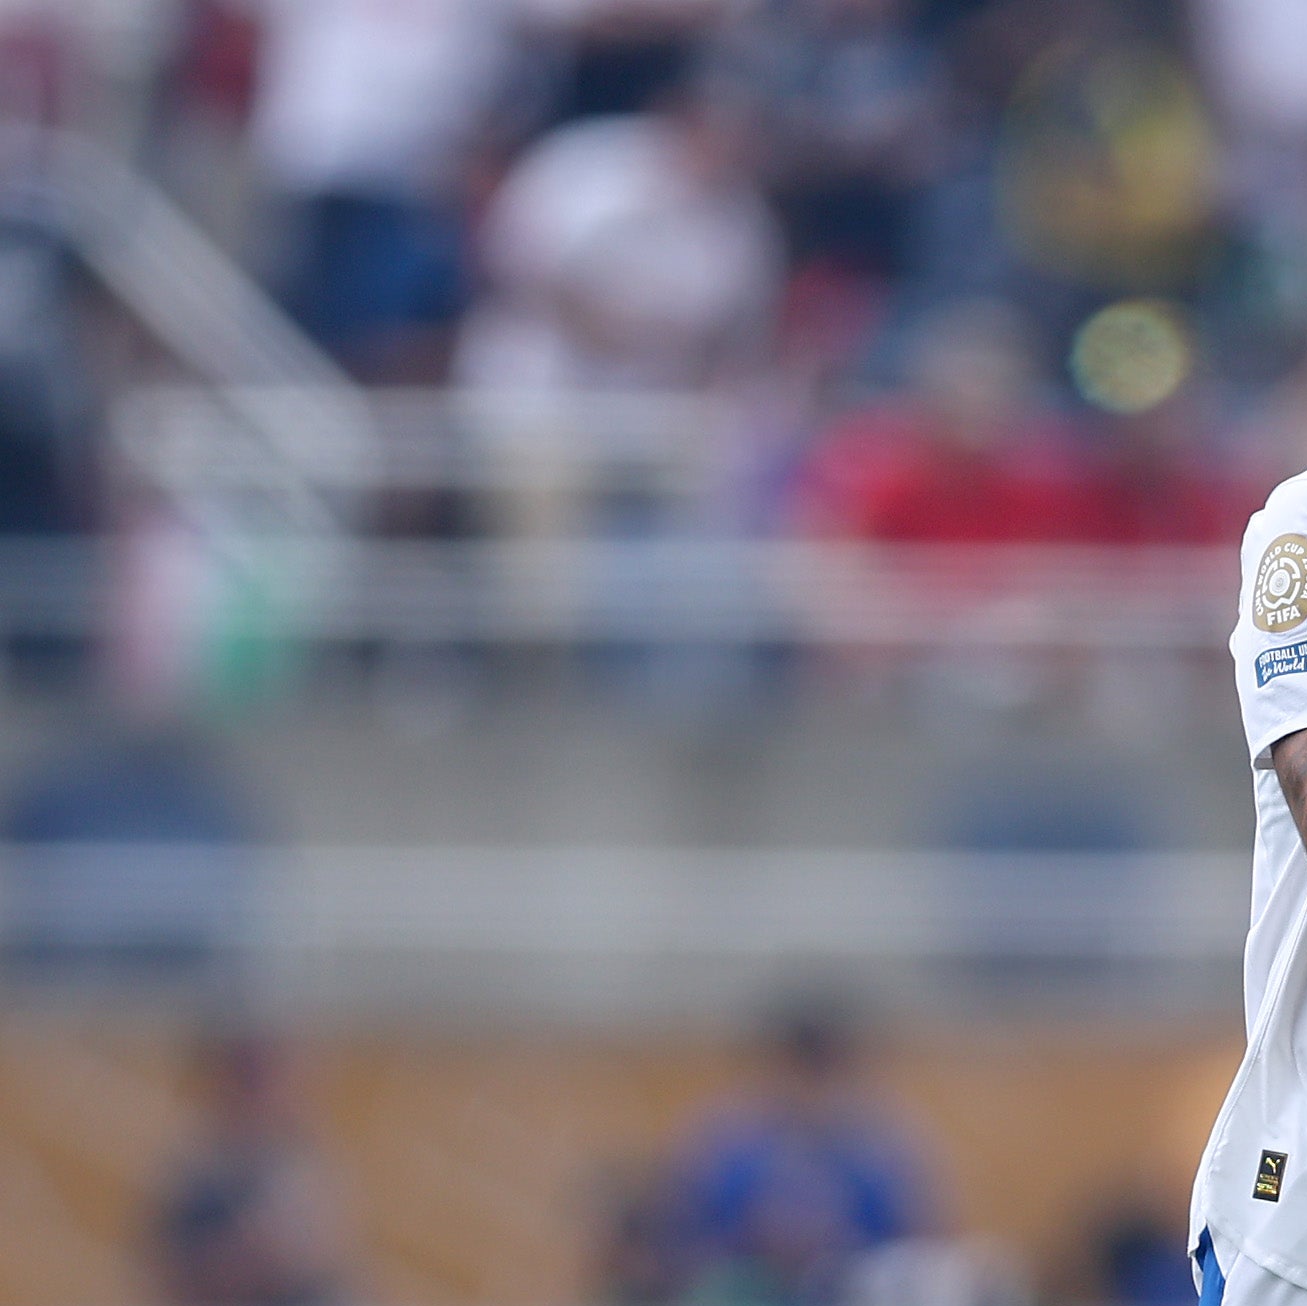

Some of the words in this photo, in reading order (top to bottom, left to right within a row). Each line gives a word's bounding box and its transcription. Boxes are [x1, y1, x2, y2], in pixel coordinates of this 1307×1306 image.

[1257, 545, 1282, 586] WORLD
[1283, 542, 1305, 556] CUP
[1266, 605, 1301, 626] FIFA
[1259, 646, 1298, 668] FOOTBALL
[1273, 656, 1305, 675] World
